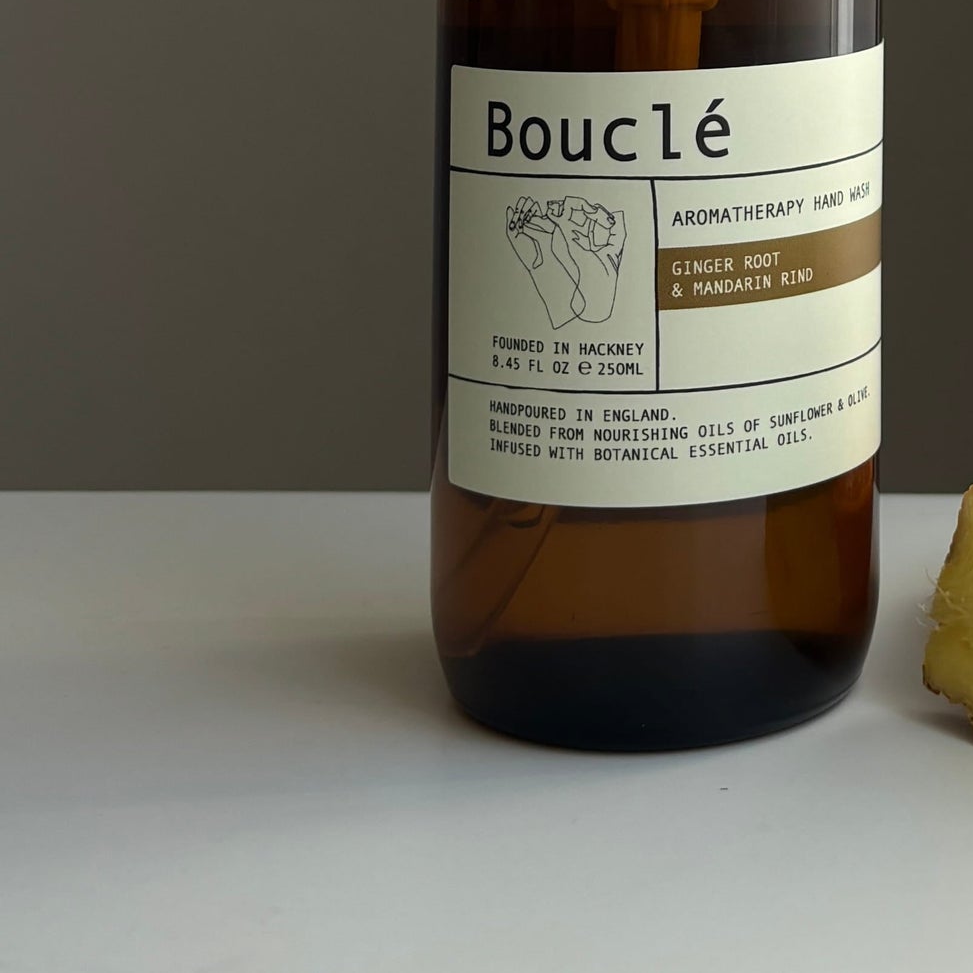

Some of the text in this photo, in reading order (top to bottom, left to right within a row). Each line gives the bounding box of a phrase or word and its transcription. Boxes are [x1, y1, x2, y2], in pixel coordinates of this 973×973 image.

[487, 98, 731, 163] Bouclé
[671, 181, 870, 227] AROMATHERAPY HAND WASH
[672, 251, 781, 276] GINGER ROOT
[671, 267, 813, 298] & MANDARIN RIND
[492, 335, 644, 357] FOUNDED IN HACKNEY
[492, 354, 520, 371] 8.45
[528, 358, 544, 373] FL
[552, 360, 570, 375] OZ
[597, 362, 644, 376] 250ML
[489, 399, 676, 423] HANDPOURED IN ENGLAND.
[489, 418, 541, 438] BLENDED
[549, 426, 584, 441] FROM
[593, 426, 688, 442] NOURISHING
[697, 421, 735, 438] OILS
[743, 418, 760, 433] OF
[769, 402, 833, 429] SUNFLOWER
[837, 398, 844, 412] &
[490, 427, 812, 462] INFUSED WITH BOTANICAL ESSENTIAL OILS.
